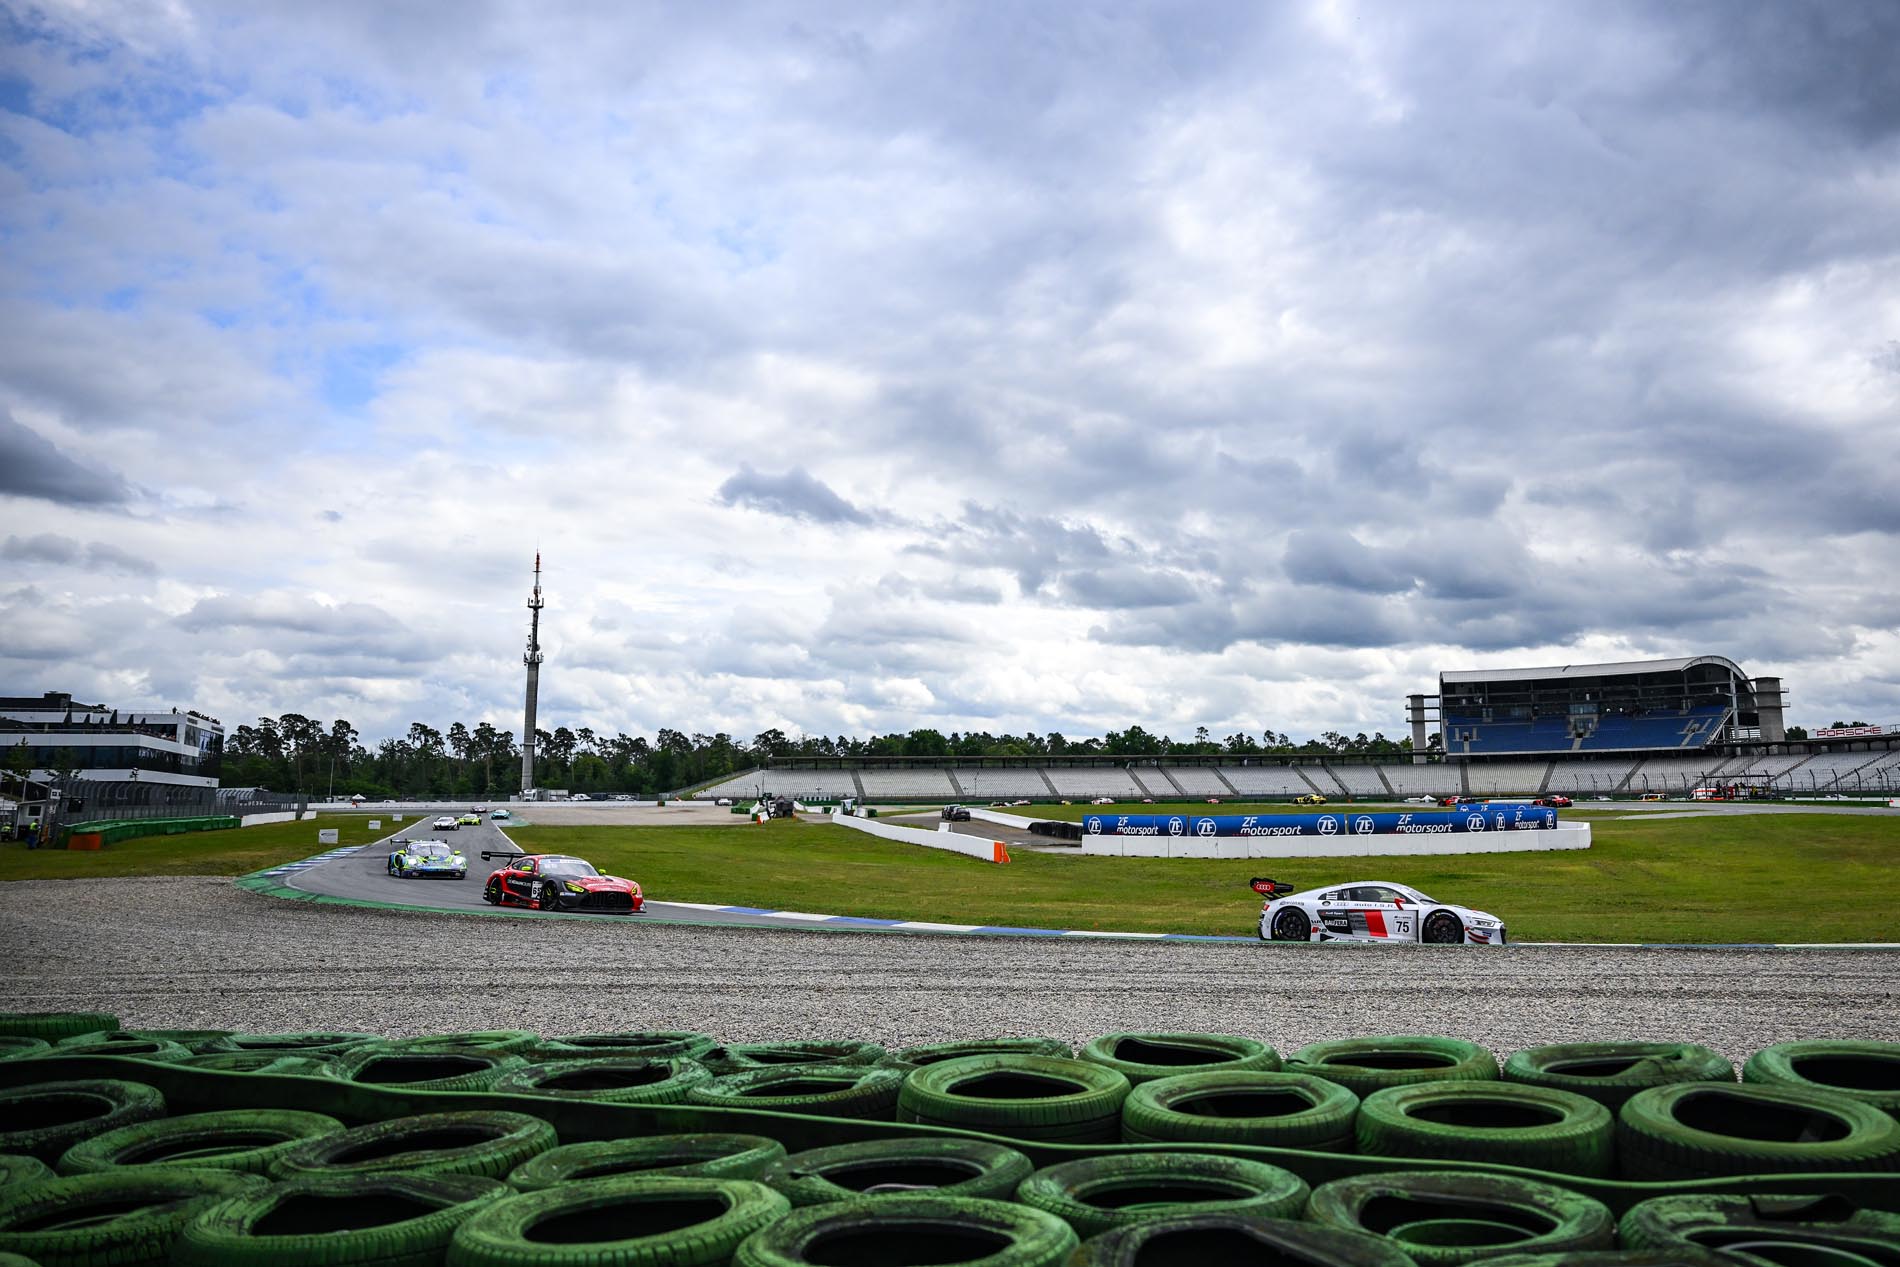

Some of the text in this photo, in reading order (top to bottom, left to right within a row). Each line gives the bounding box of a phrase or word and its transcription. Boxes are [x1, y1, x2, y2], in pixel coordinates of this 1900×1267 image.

[1816, 726, 1882, 737] PORSCHE
[1117, 816, 1129, 826] ZF
[1242, 816, 1258, 827] ZF
[1398, 814, 1413, 824] ZF
[1515, 811, 1523, 821] ZF
[1116, 825, 1158, 836] motorsport
[1240, 825, 1302, 836] motorsport
[1396, 822, 1453, 834] motorsport
[1515, 820, 1540, 830] motorsport
[1395, 920, 1410, 933] 75
